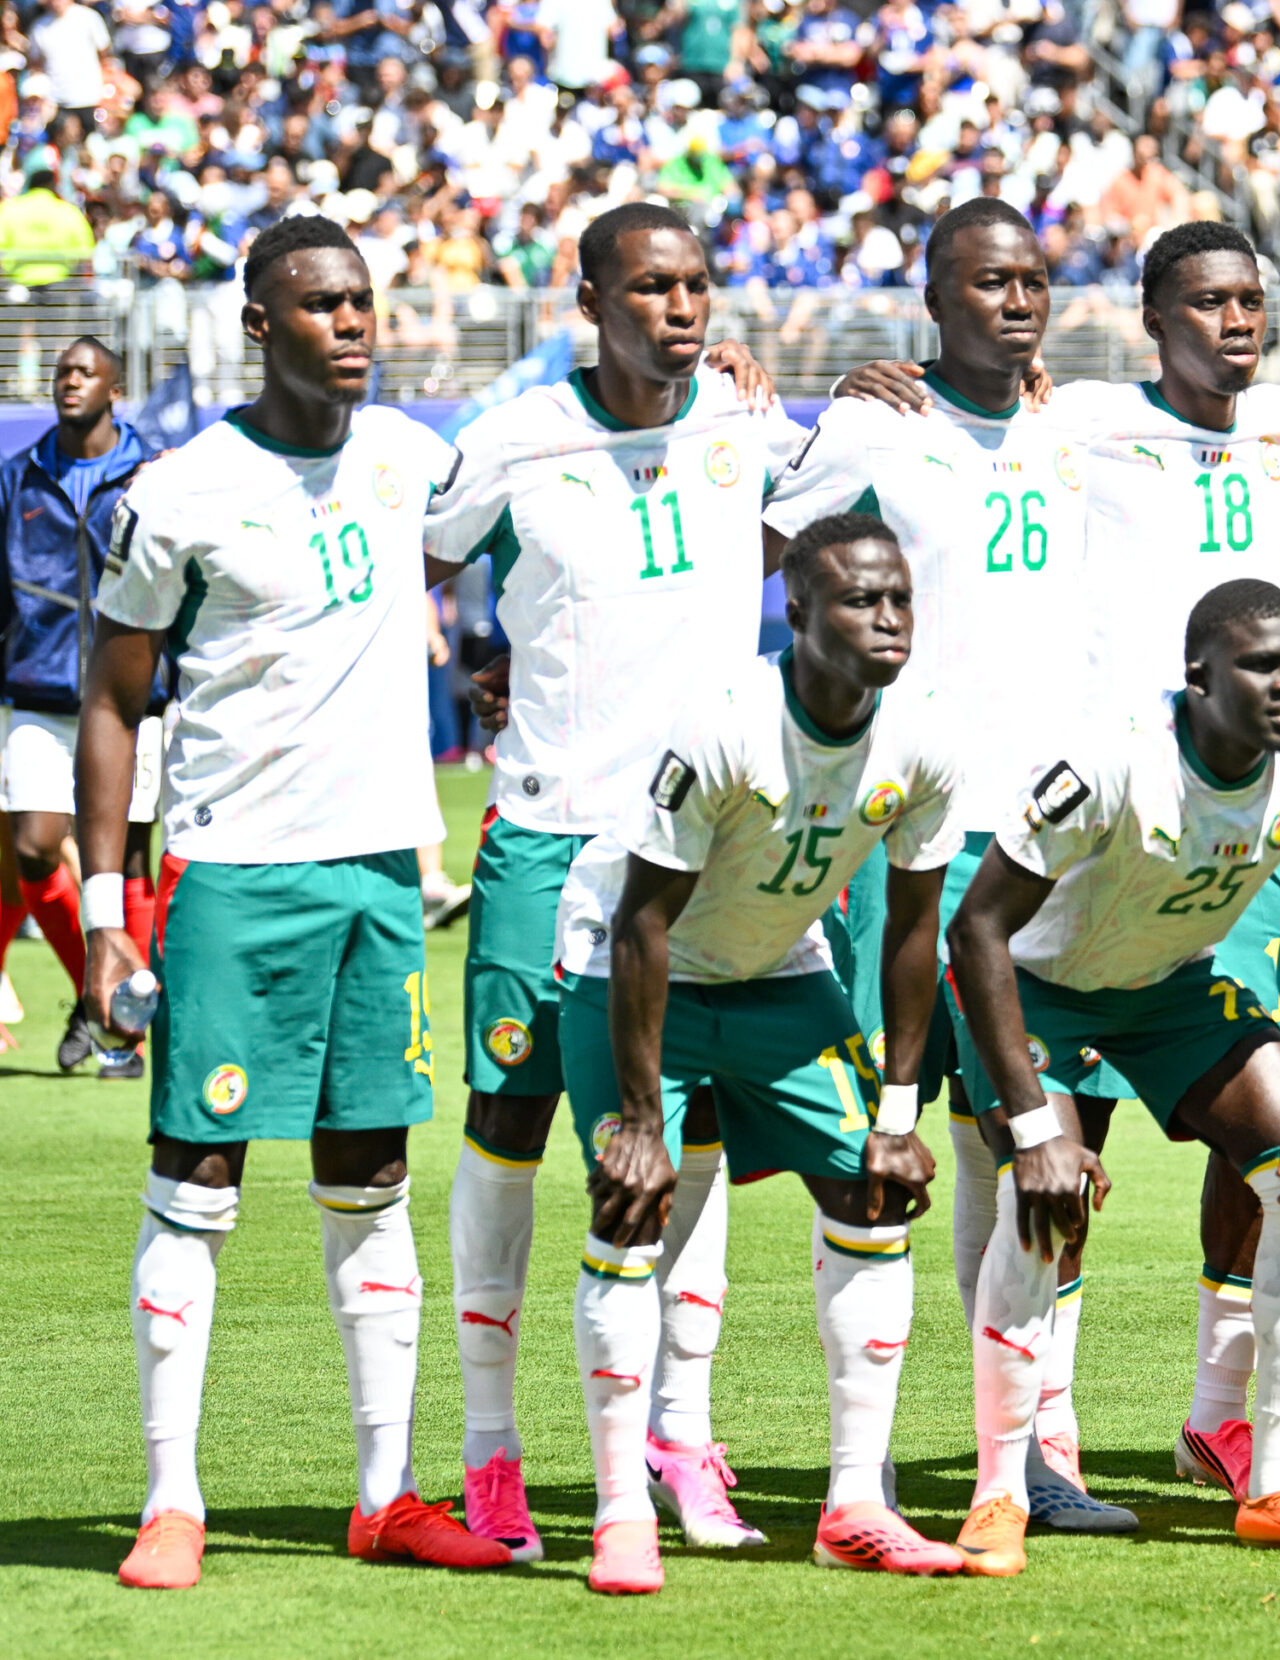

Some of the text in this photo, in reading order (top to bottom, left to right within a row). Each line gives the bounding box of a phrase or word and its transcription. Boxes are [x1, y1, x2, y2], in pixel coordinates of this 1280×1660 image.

[630, 490, 694, 580] 11
[984, 490, 1048, 573] 26
[1194, 473, 1254, 553] 18
[309, 521, 374, 610] 19
[757, 825, 844, 895] 15
[1157, 862, 1258, 915] 25
